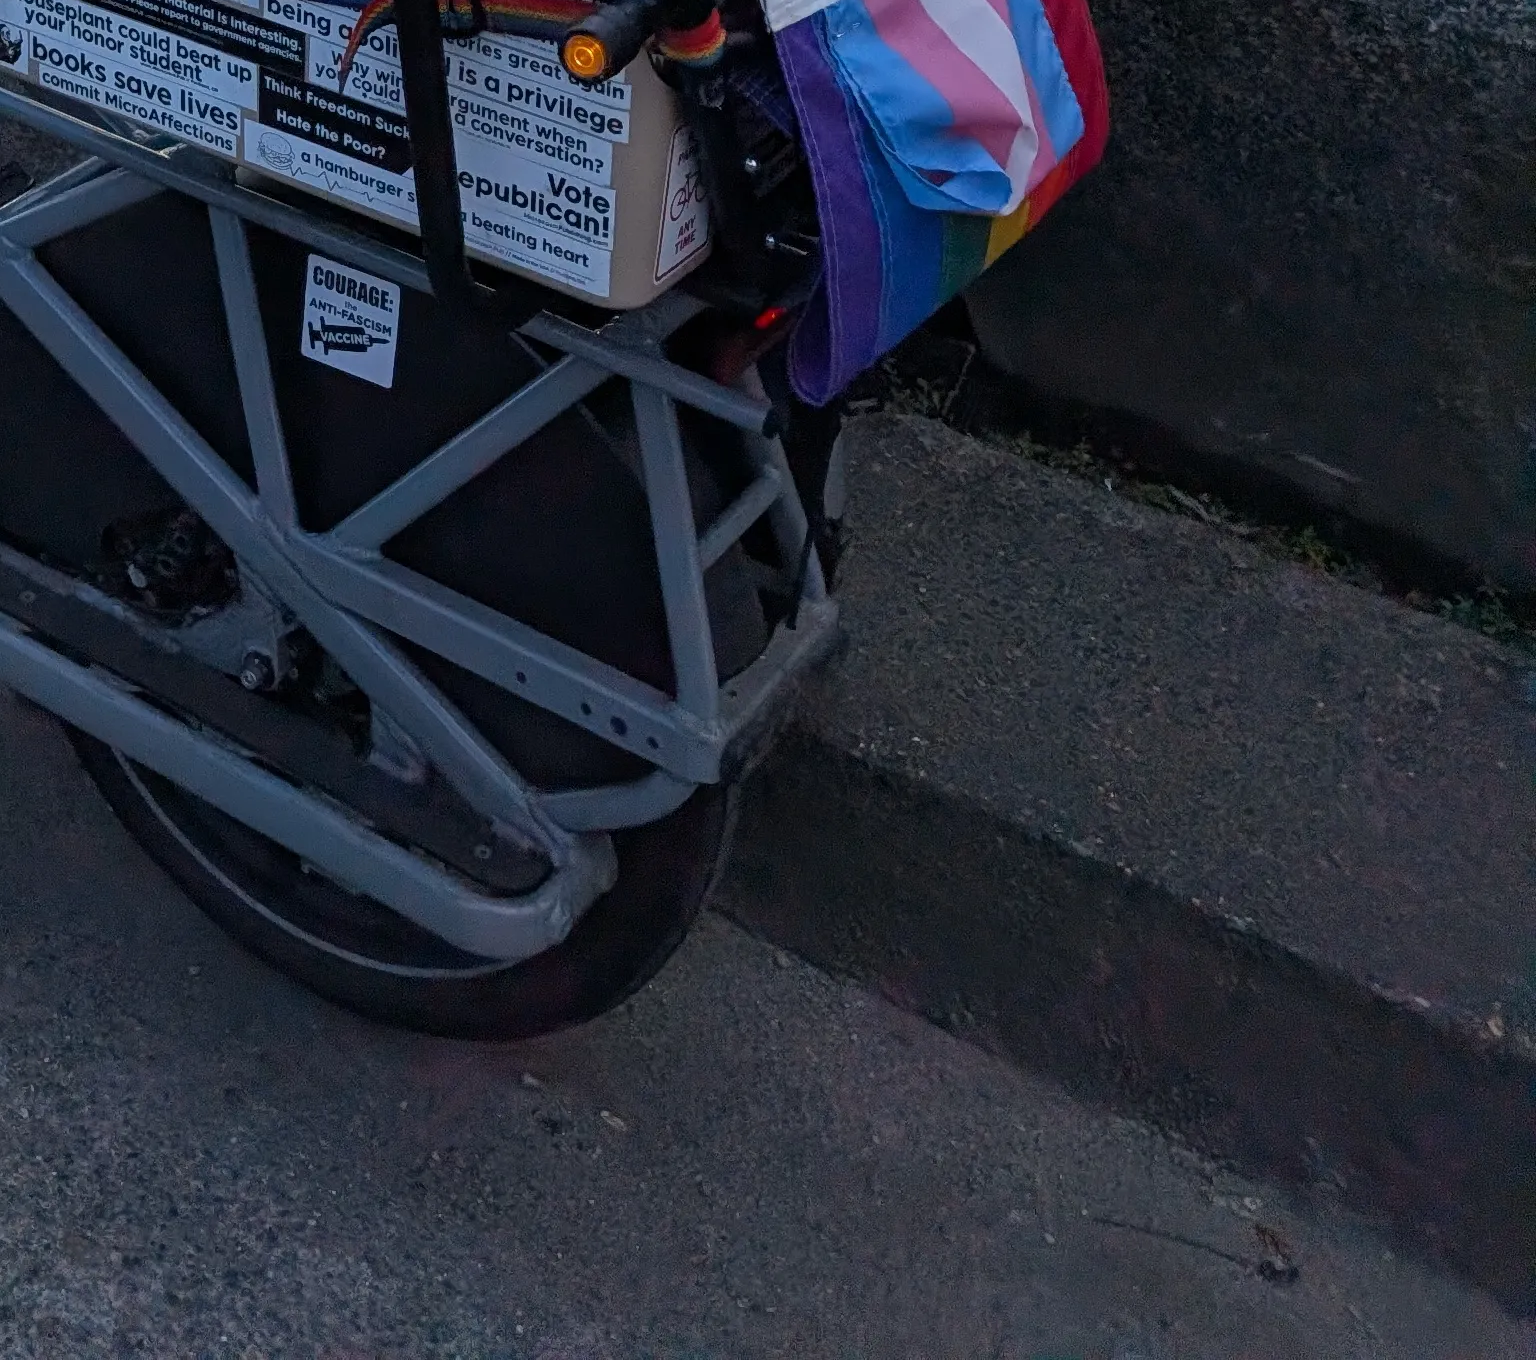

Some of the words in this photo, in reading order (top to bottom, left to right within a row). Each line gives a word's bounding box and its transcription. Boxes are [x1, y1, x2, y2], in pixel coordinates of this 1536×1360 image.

[25, 7, 65, 32] your
[71, 20, 124, 54] honor
[130, 43, 203, 82] student
[118, 24, 170, 54] could
[177, 39, 221, 72] beat
[227, 62, 252, 83] up
[161, 6, 188, 24] report
[191, 15, 201, 26] to
[202, 21, 257, 48] government
[33, 35, 107, 83] books
[114, 71, 172, 106] save
[180, 88, 238, 131] lives
[508, 53, 562, 80] great
[42, 72, 100, 102] commit
[105, 91, 233, 151] MicroAffections
[264, 75, 302, 101] Think
[306, 91, 371, 126] Freedom
[352, 76, 401, 102] could
[455, 113, 466, 127] a
[470, 119, 604, 174] conversation?
[458, 61, 477, 85] is
[484, 76, 500, 94] a
[507, 82, 624, 135] privilege
[276, 108, 312, 132] Hate
[315, 122, 339, 143] the
[343, 132, 386, 160] Poor?
[547, 171, 610, 214] Vote
[535, 124, 587, 153] when
[301, 151, 311, 164] a
[315, 153, 404, 198] hamburger
[472, 211, 537, 251] beating
[543, 237, 590, 268] heart
[457, 170, 610, 239] epublican!
[309, 297, 392, 338] ANTI-FASCISM
[313, 265, 394, 314] COURAGE:
[344, 300, 358, 312] the
[320, 331, 371, 346] VACCINE
